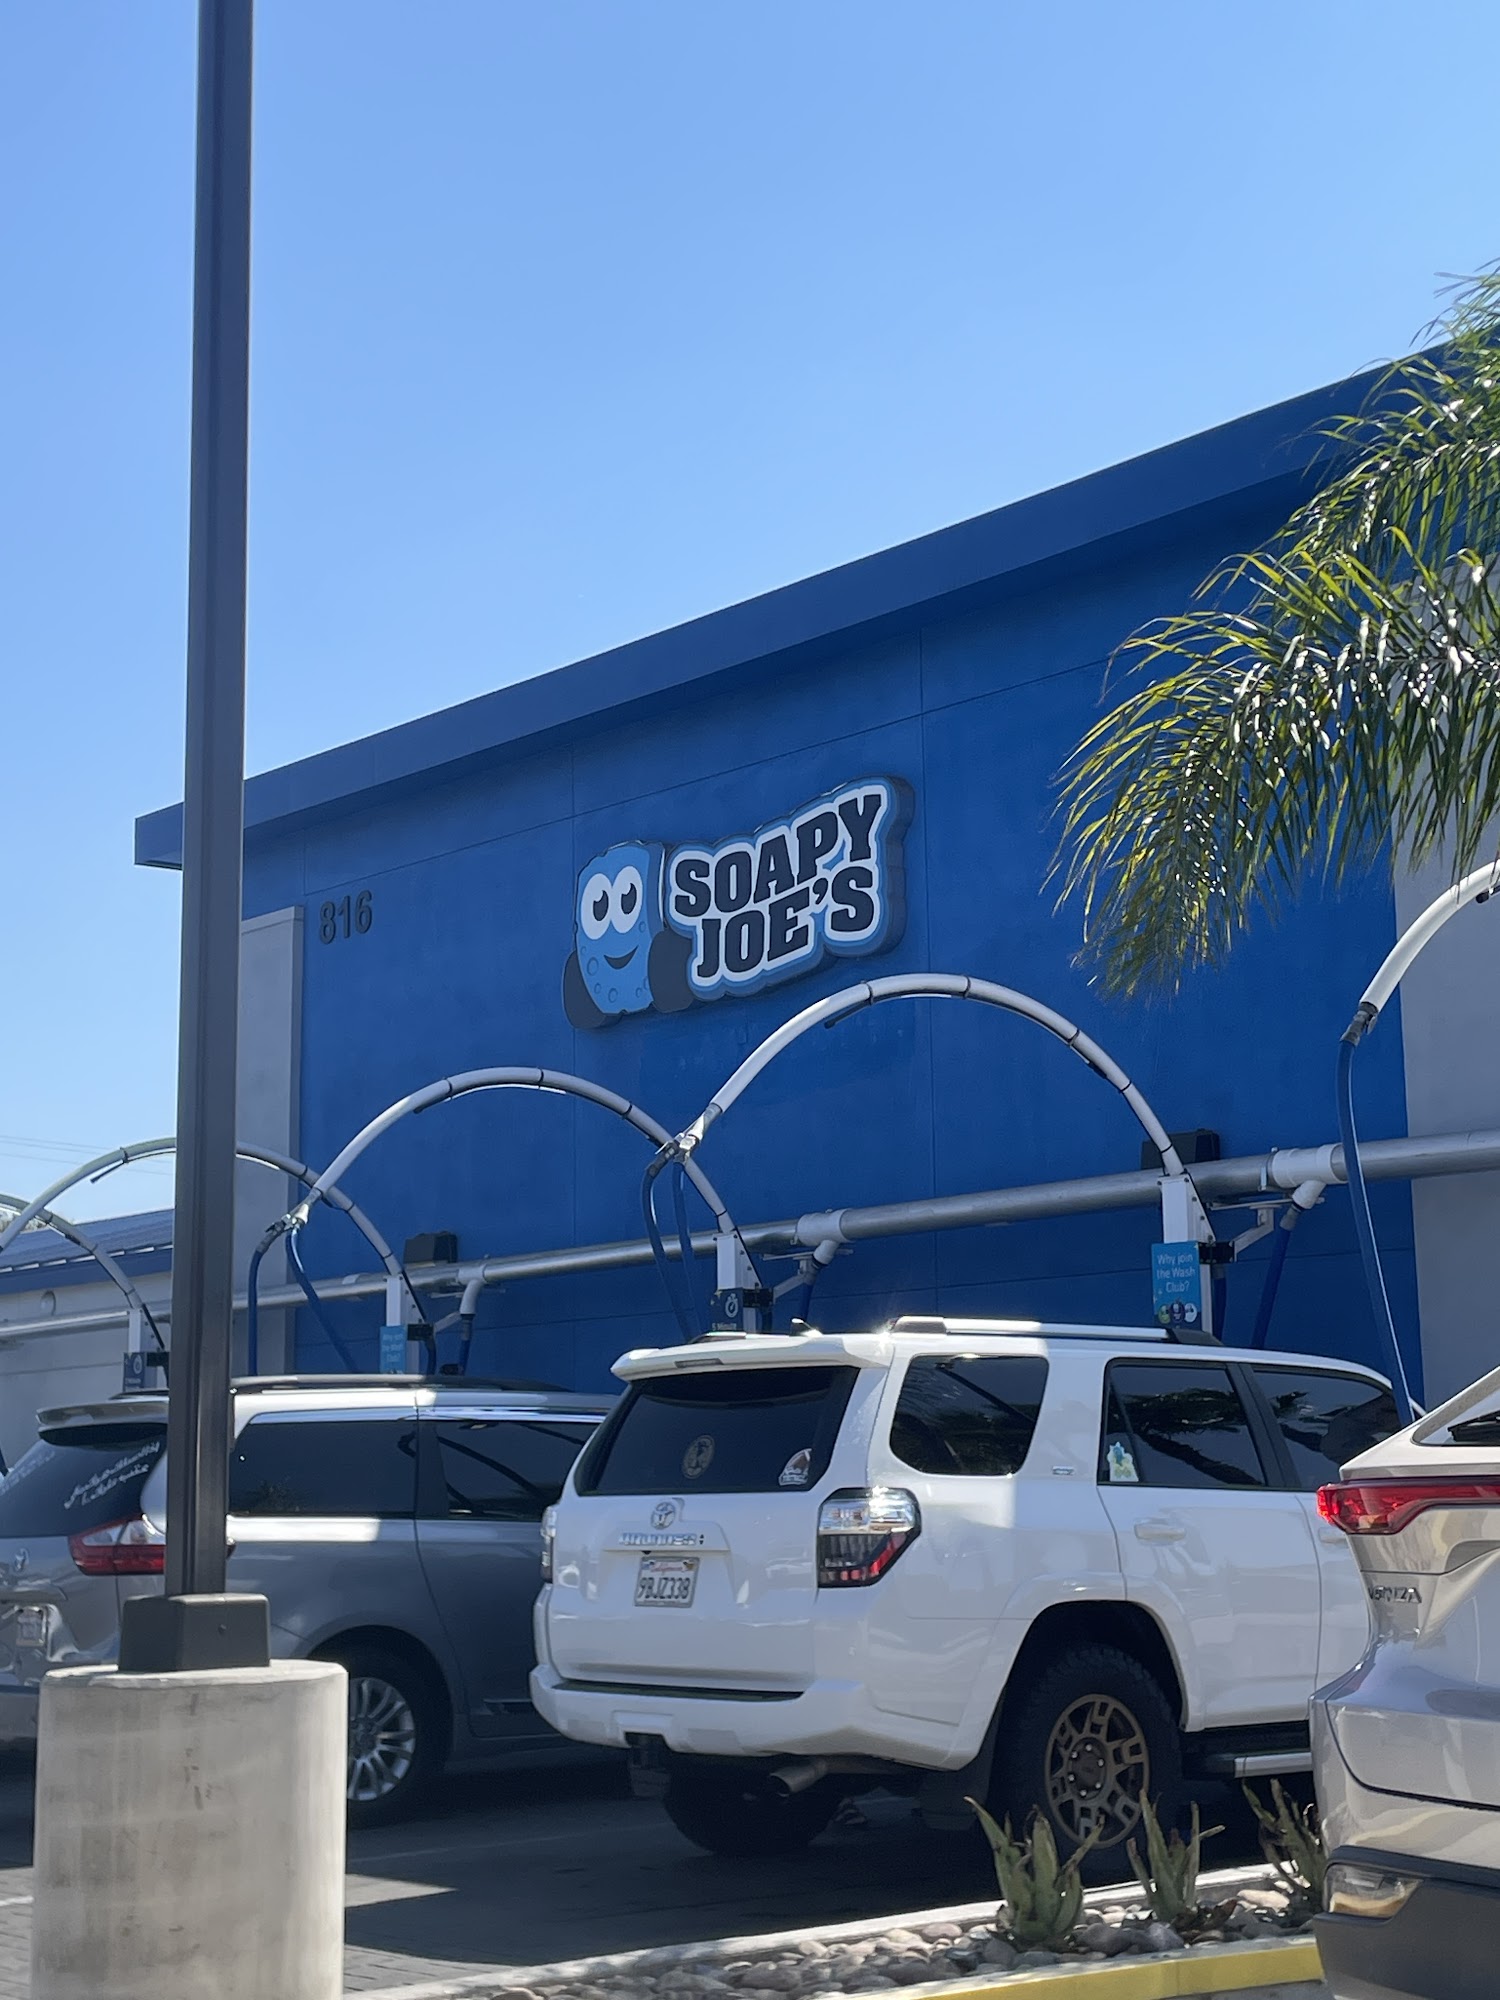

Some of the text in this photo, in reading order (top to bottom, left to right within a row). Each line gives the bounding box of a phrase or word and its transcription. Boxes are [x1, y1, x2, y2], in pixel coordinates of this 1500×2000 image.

[675, 793, 881, 918] SOAPY
[319, 890, 373, 946] 816
[696, 865, 875, 978] JOE'S
[1156, 1266, 1196, 1280] the Wash
[1157, 1252, 1194, 1265] Why join
[1165, 1280, 1190, 1293] Club?
